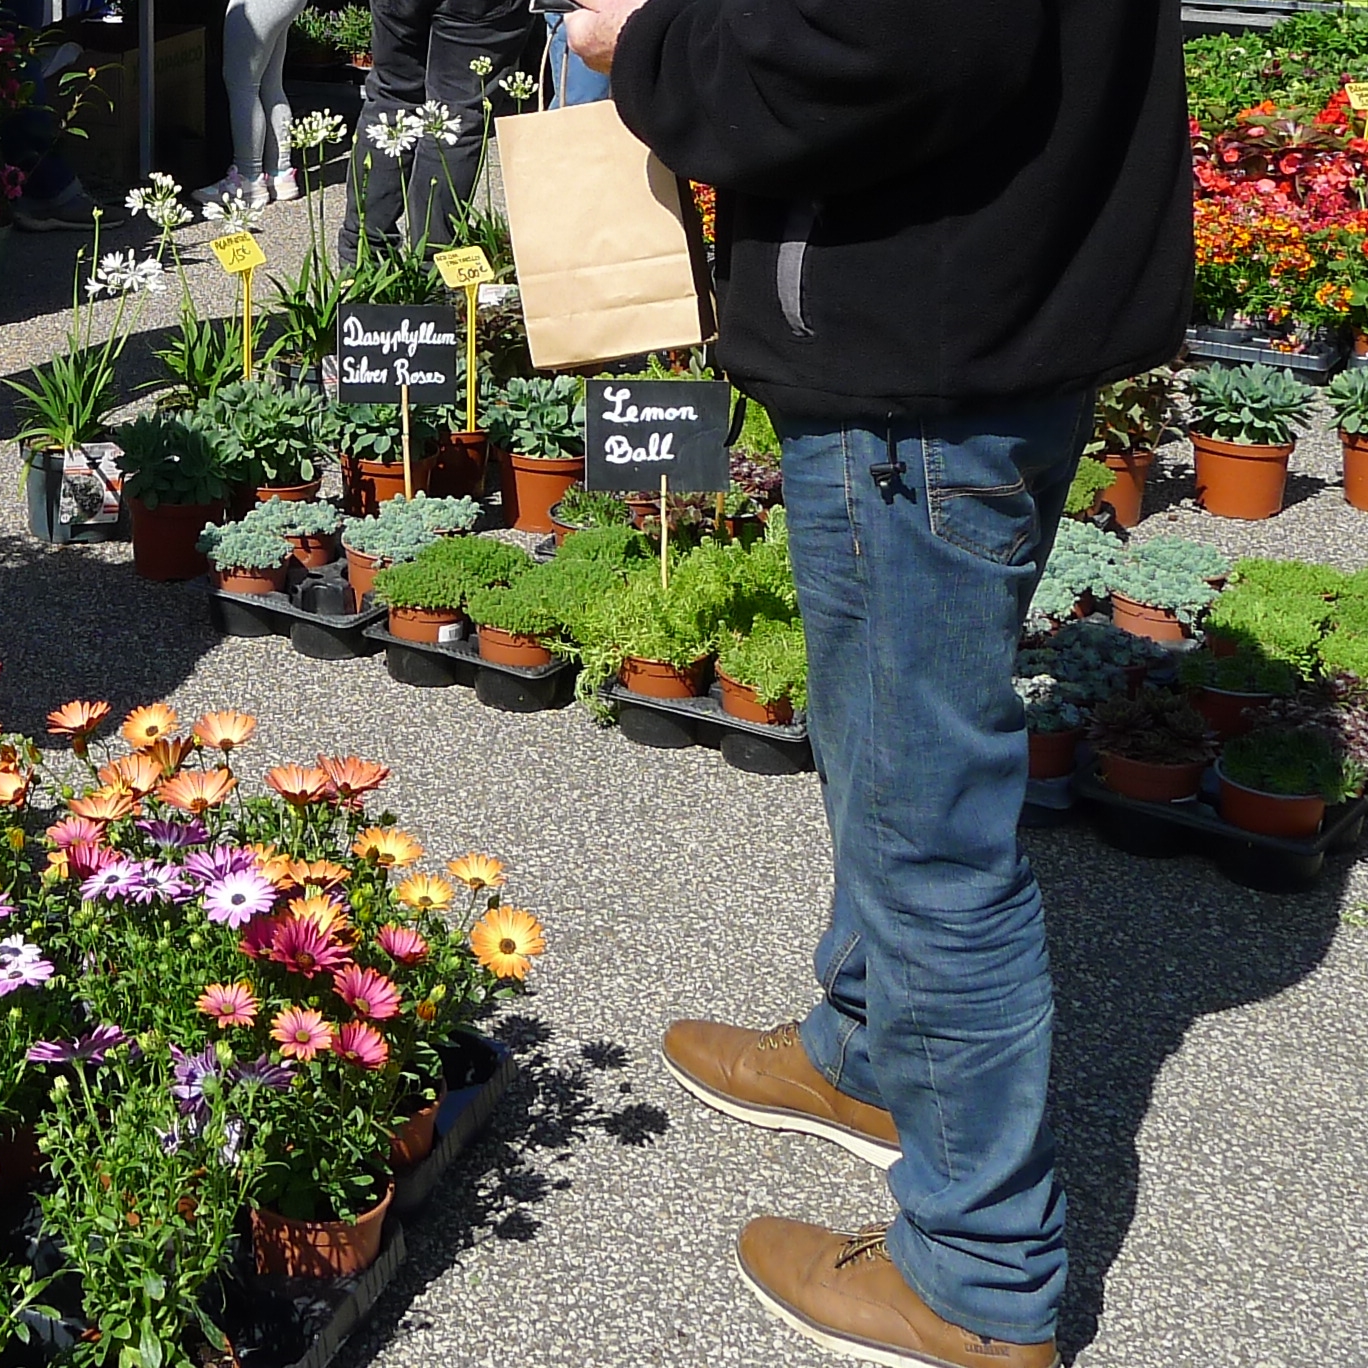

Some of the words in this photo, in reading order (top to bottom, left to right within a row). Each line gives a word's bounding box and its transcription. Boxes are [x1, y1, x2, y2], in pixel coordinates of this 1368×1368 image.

[343, 314, 457, 357] Dasyphyllum
[342, 356, 388, 384] Silver
[602, 386, 698, 423] Lemon
[604, 432, 675, 464] Ball
